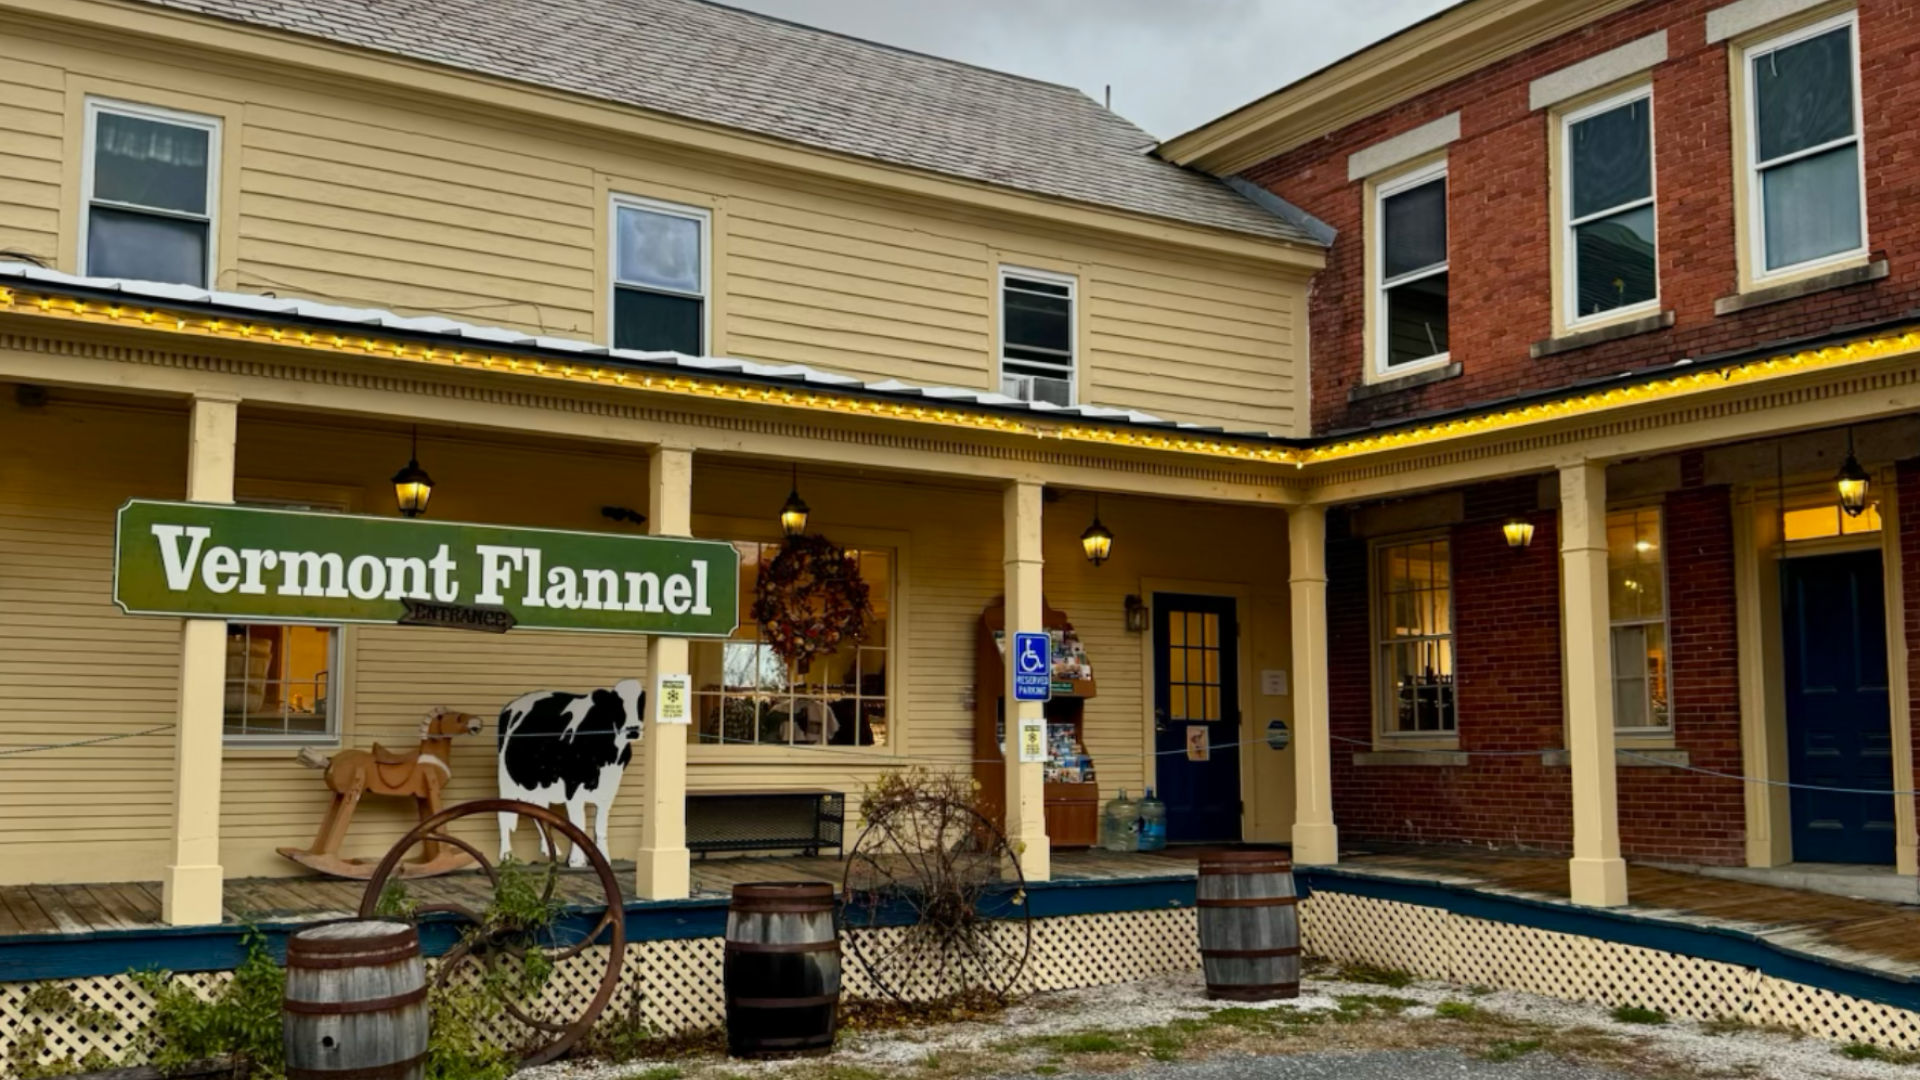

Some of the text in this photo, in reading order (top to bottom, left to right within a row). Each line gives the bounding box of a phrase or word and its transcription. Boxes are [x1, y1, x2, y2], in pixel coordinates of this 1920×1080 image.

[151, 524, 711, 616] Vermont Flannel
[415, 603, 507, 627] ENTRANCE
[1017, 675, 1049, 685] RESERVED
[1018, 686, 1047, 696] PARKING
